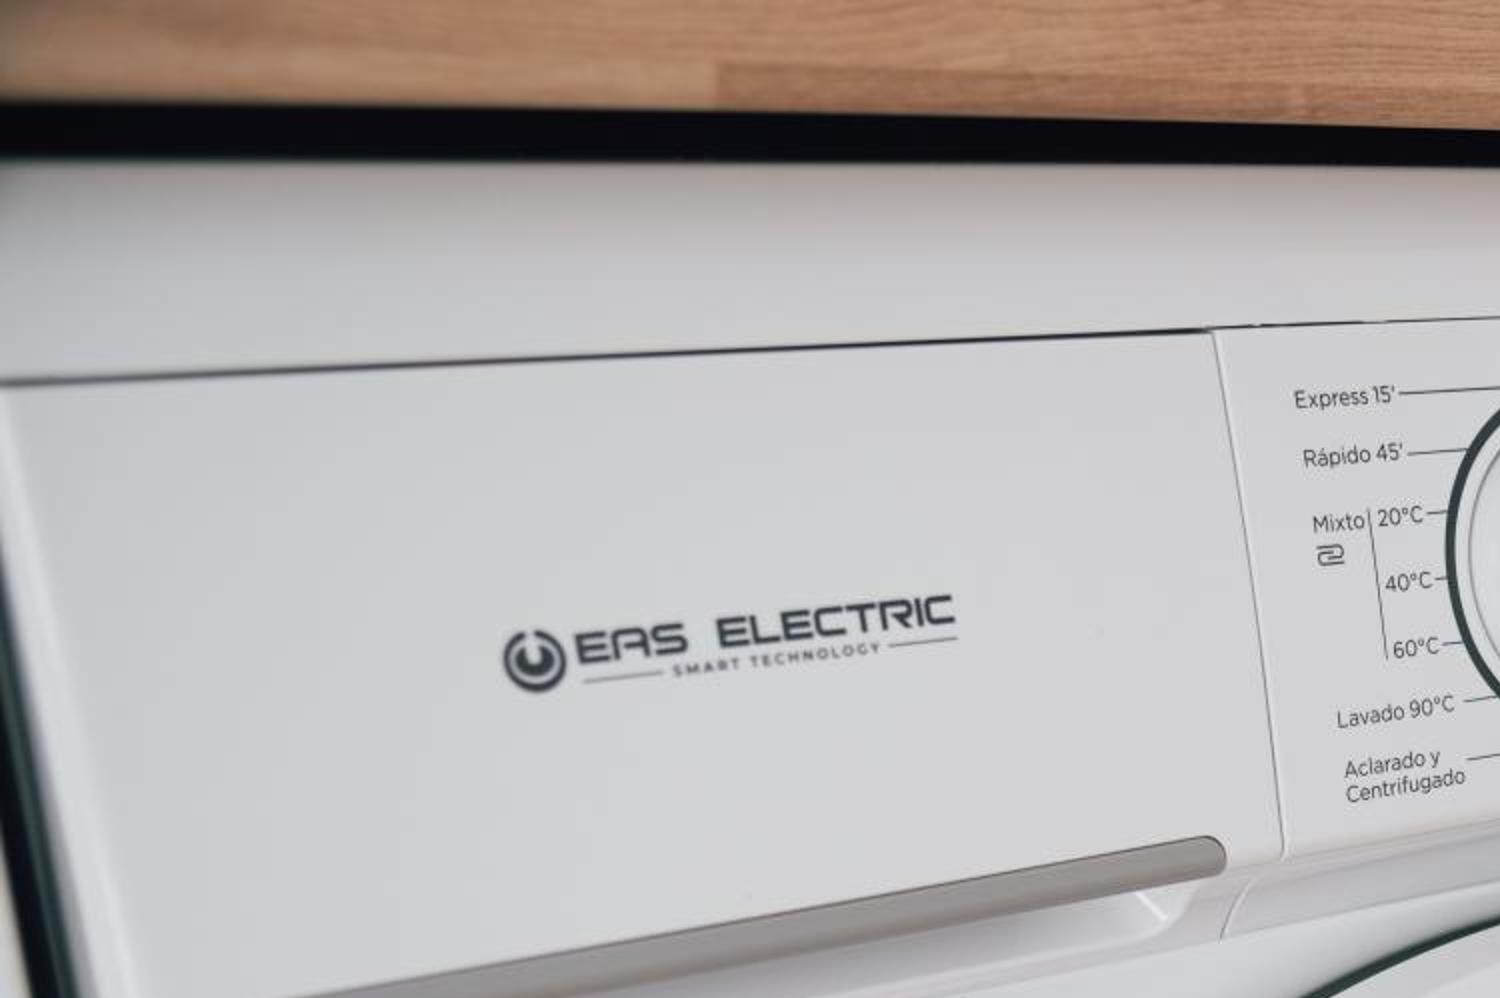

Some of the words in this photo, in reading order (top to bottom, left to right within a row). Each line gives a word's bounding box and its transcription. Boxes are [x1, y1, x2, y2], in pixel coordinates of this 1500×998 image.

[1294, 389, 1369, 410] Express
[1373, 385, 1395, 403] 15'
[1303, 444, 1371, 471] Rápido
[1375, 442, 1403, 461] 45'
[1313, 512, 1365, 534] Mixto
[1377, 505, 1424, 527] 20°C
[1385, 570, 1434, 593] 40°C
[574, 622, 689, 666] EAS
[715, 594, 956, 649] ELECTRIC
[673, 657, 740, 678] SMART
[750, 641, 882, 669] TECHNOLOGY
[1393, 636, 1441, 660] 60°C
[1337, 705, 1405, 729] Lavado
[1408, 695, 1456, 718] 90°C
[1344, 751, 1423, 779] Aclarado
[1423, 750, 1440, 769] y
[1345, 767, 1466, 803] Centrifugado
